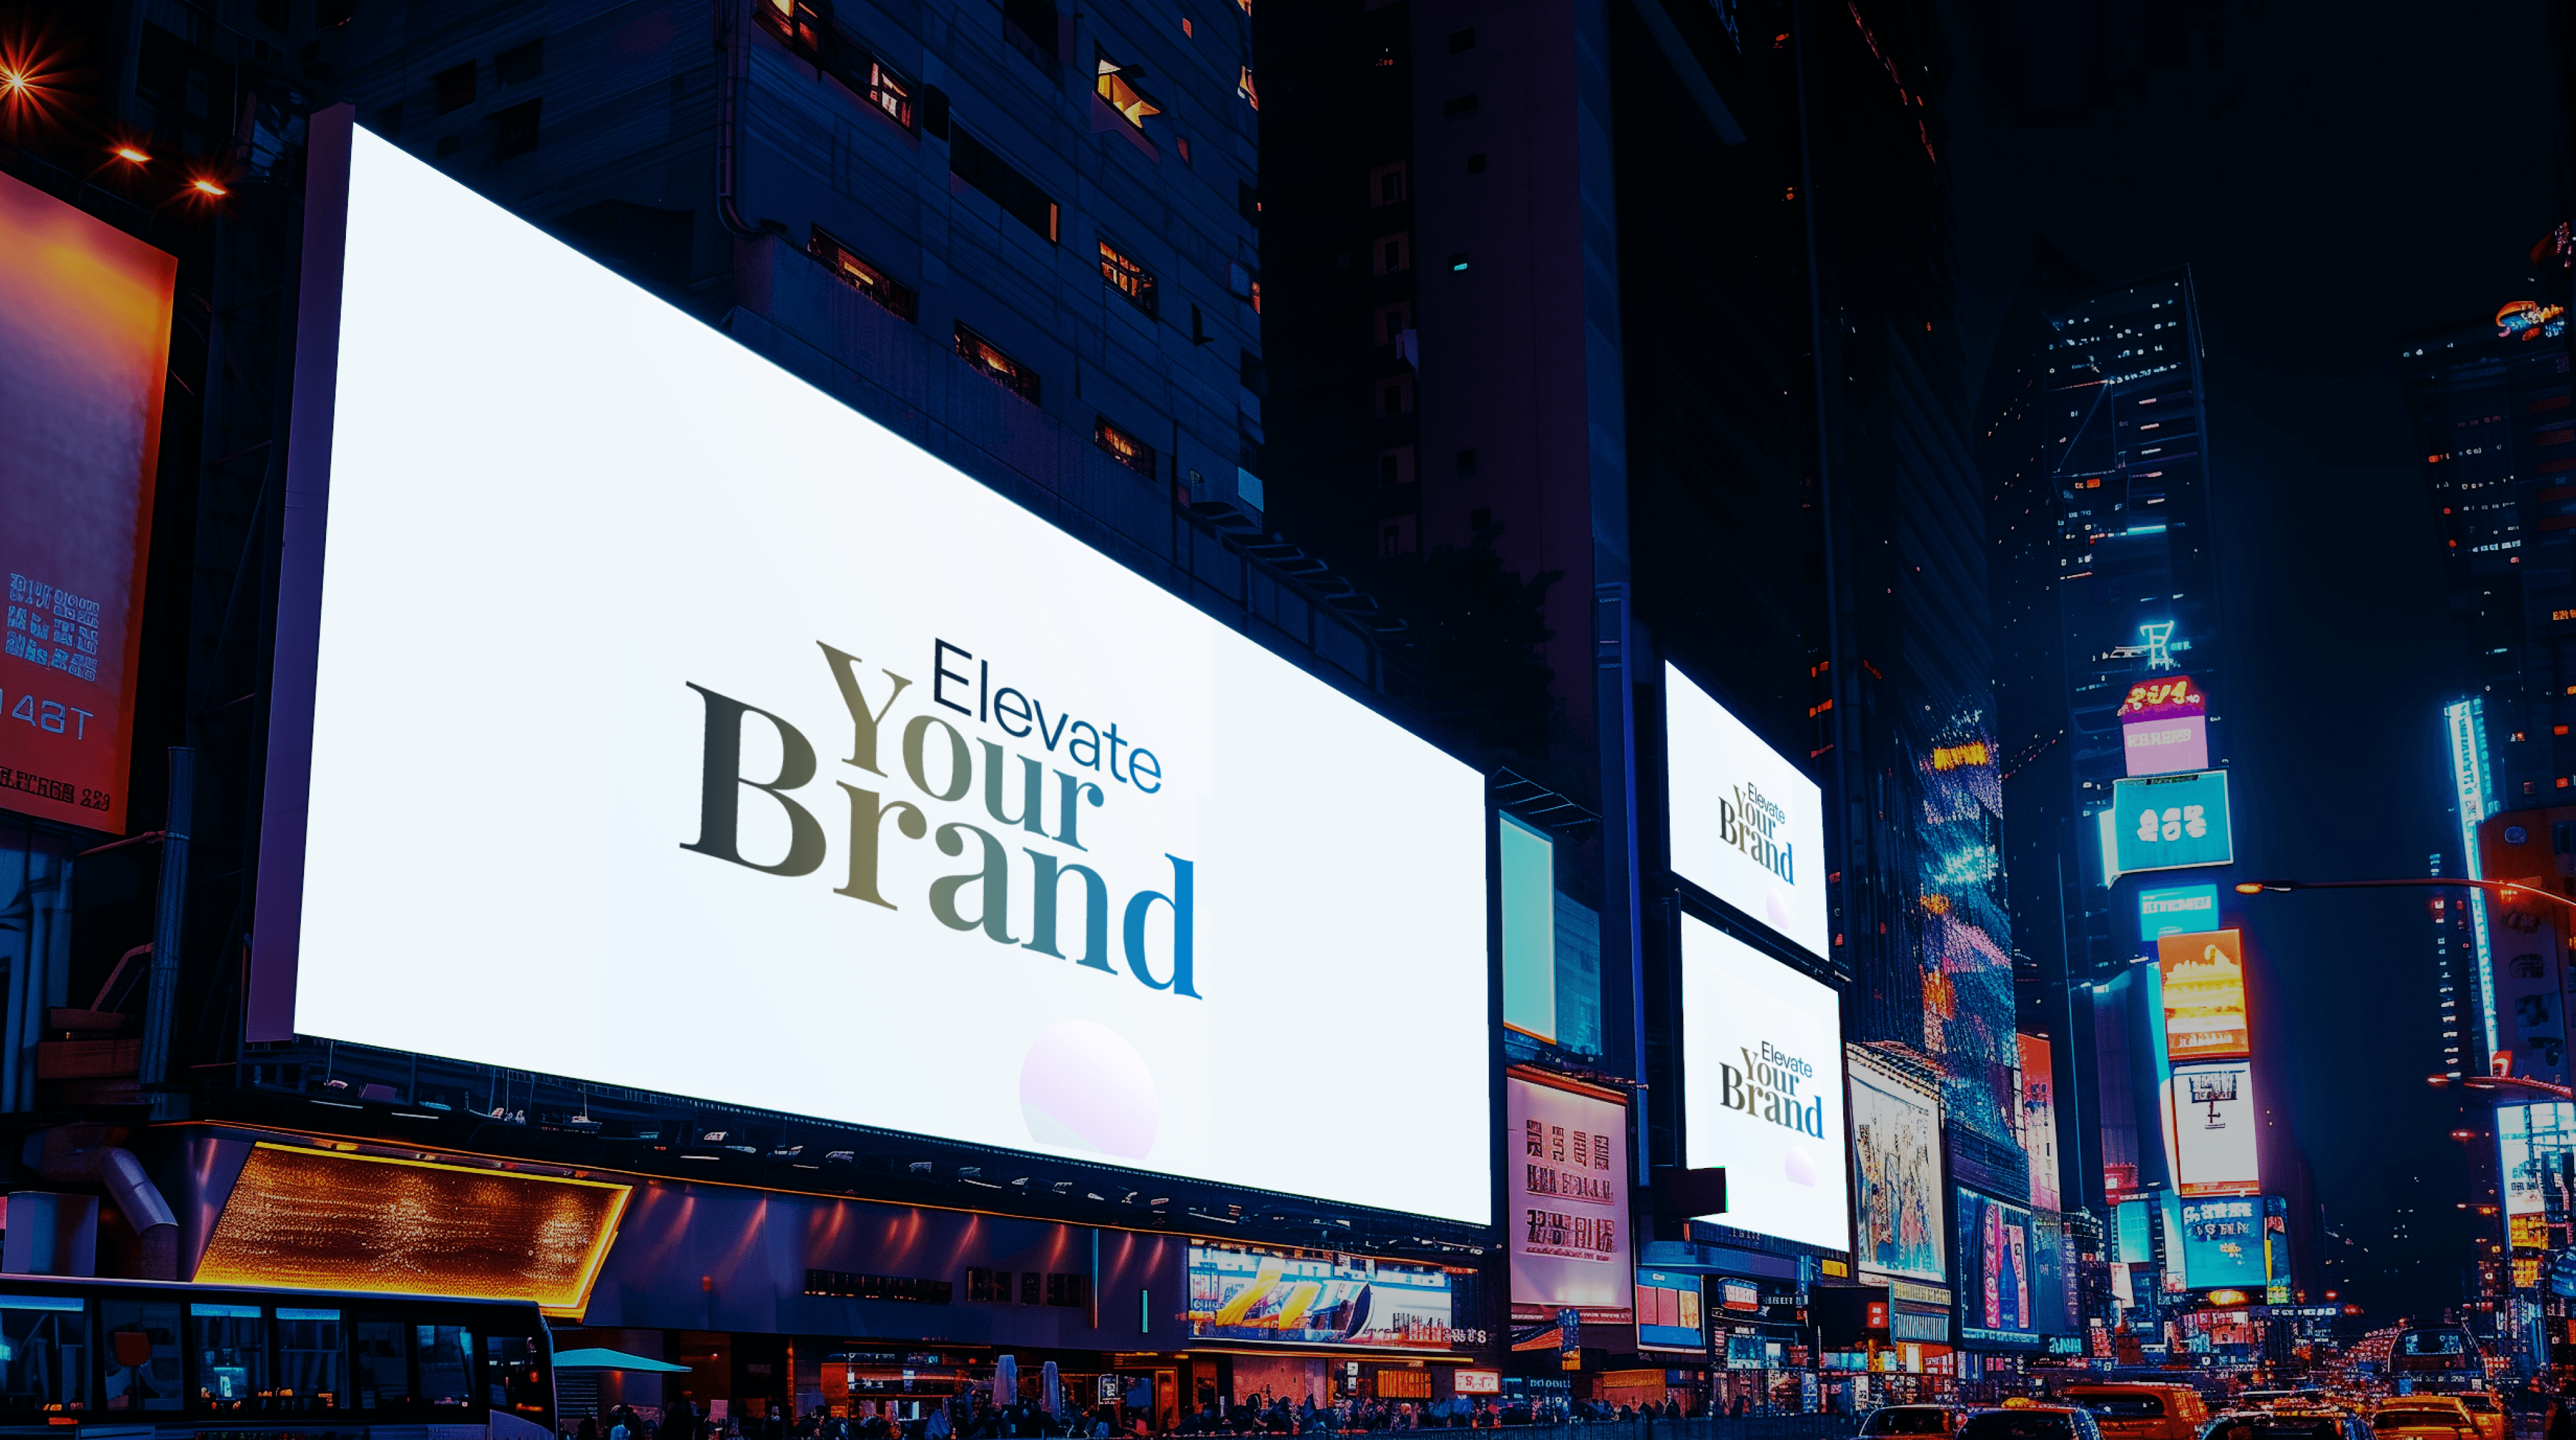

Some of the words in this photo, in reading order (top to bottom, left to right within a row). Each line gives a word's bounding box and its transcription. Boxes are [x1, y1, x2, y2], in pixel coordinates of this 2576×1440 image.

[816, 639, 1104, 853] Your
[934, 637, 1162, 794] Elevate
[679, 680, 1203, 1001] Brand
[1718, 796, 1796, 886] Brand
[1733, 785, 1776, 841] Your
[1747, 782, 1785, 825] Elevate
[1740, 1046, 1800, 1097] Your
[1761, 1040, 1812, 1079] Elevate
[1719, 1061, 1825, 1140] Brand
